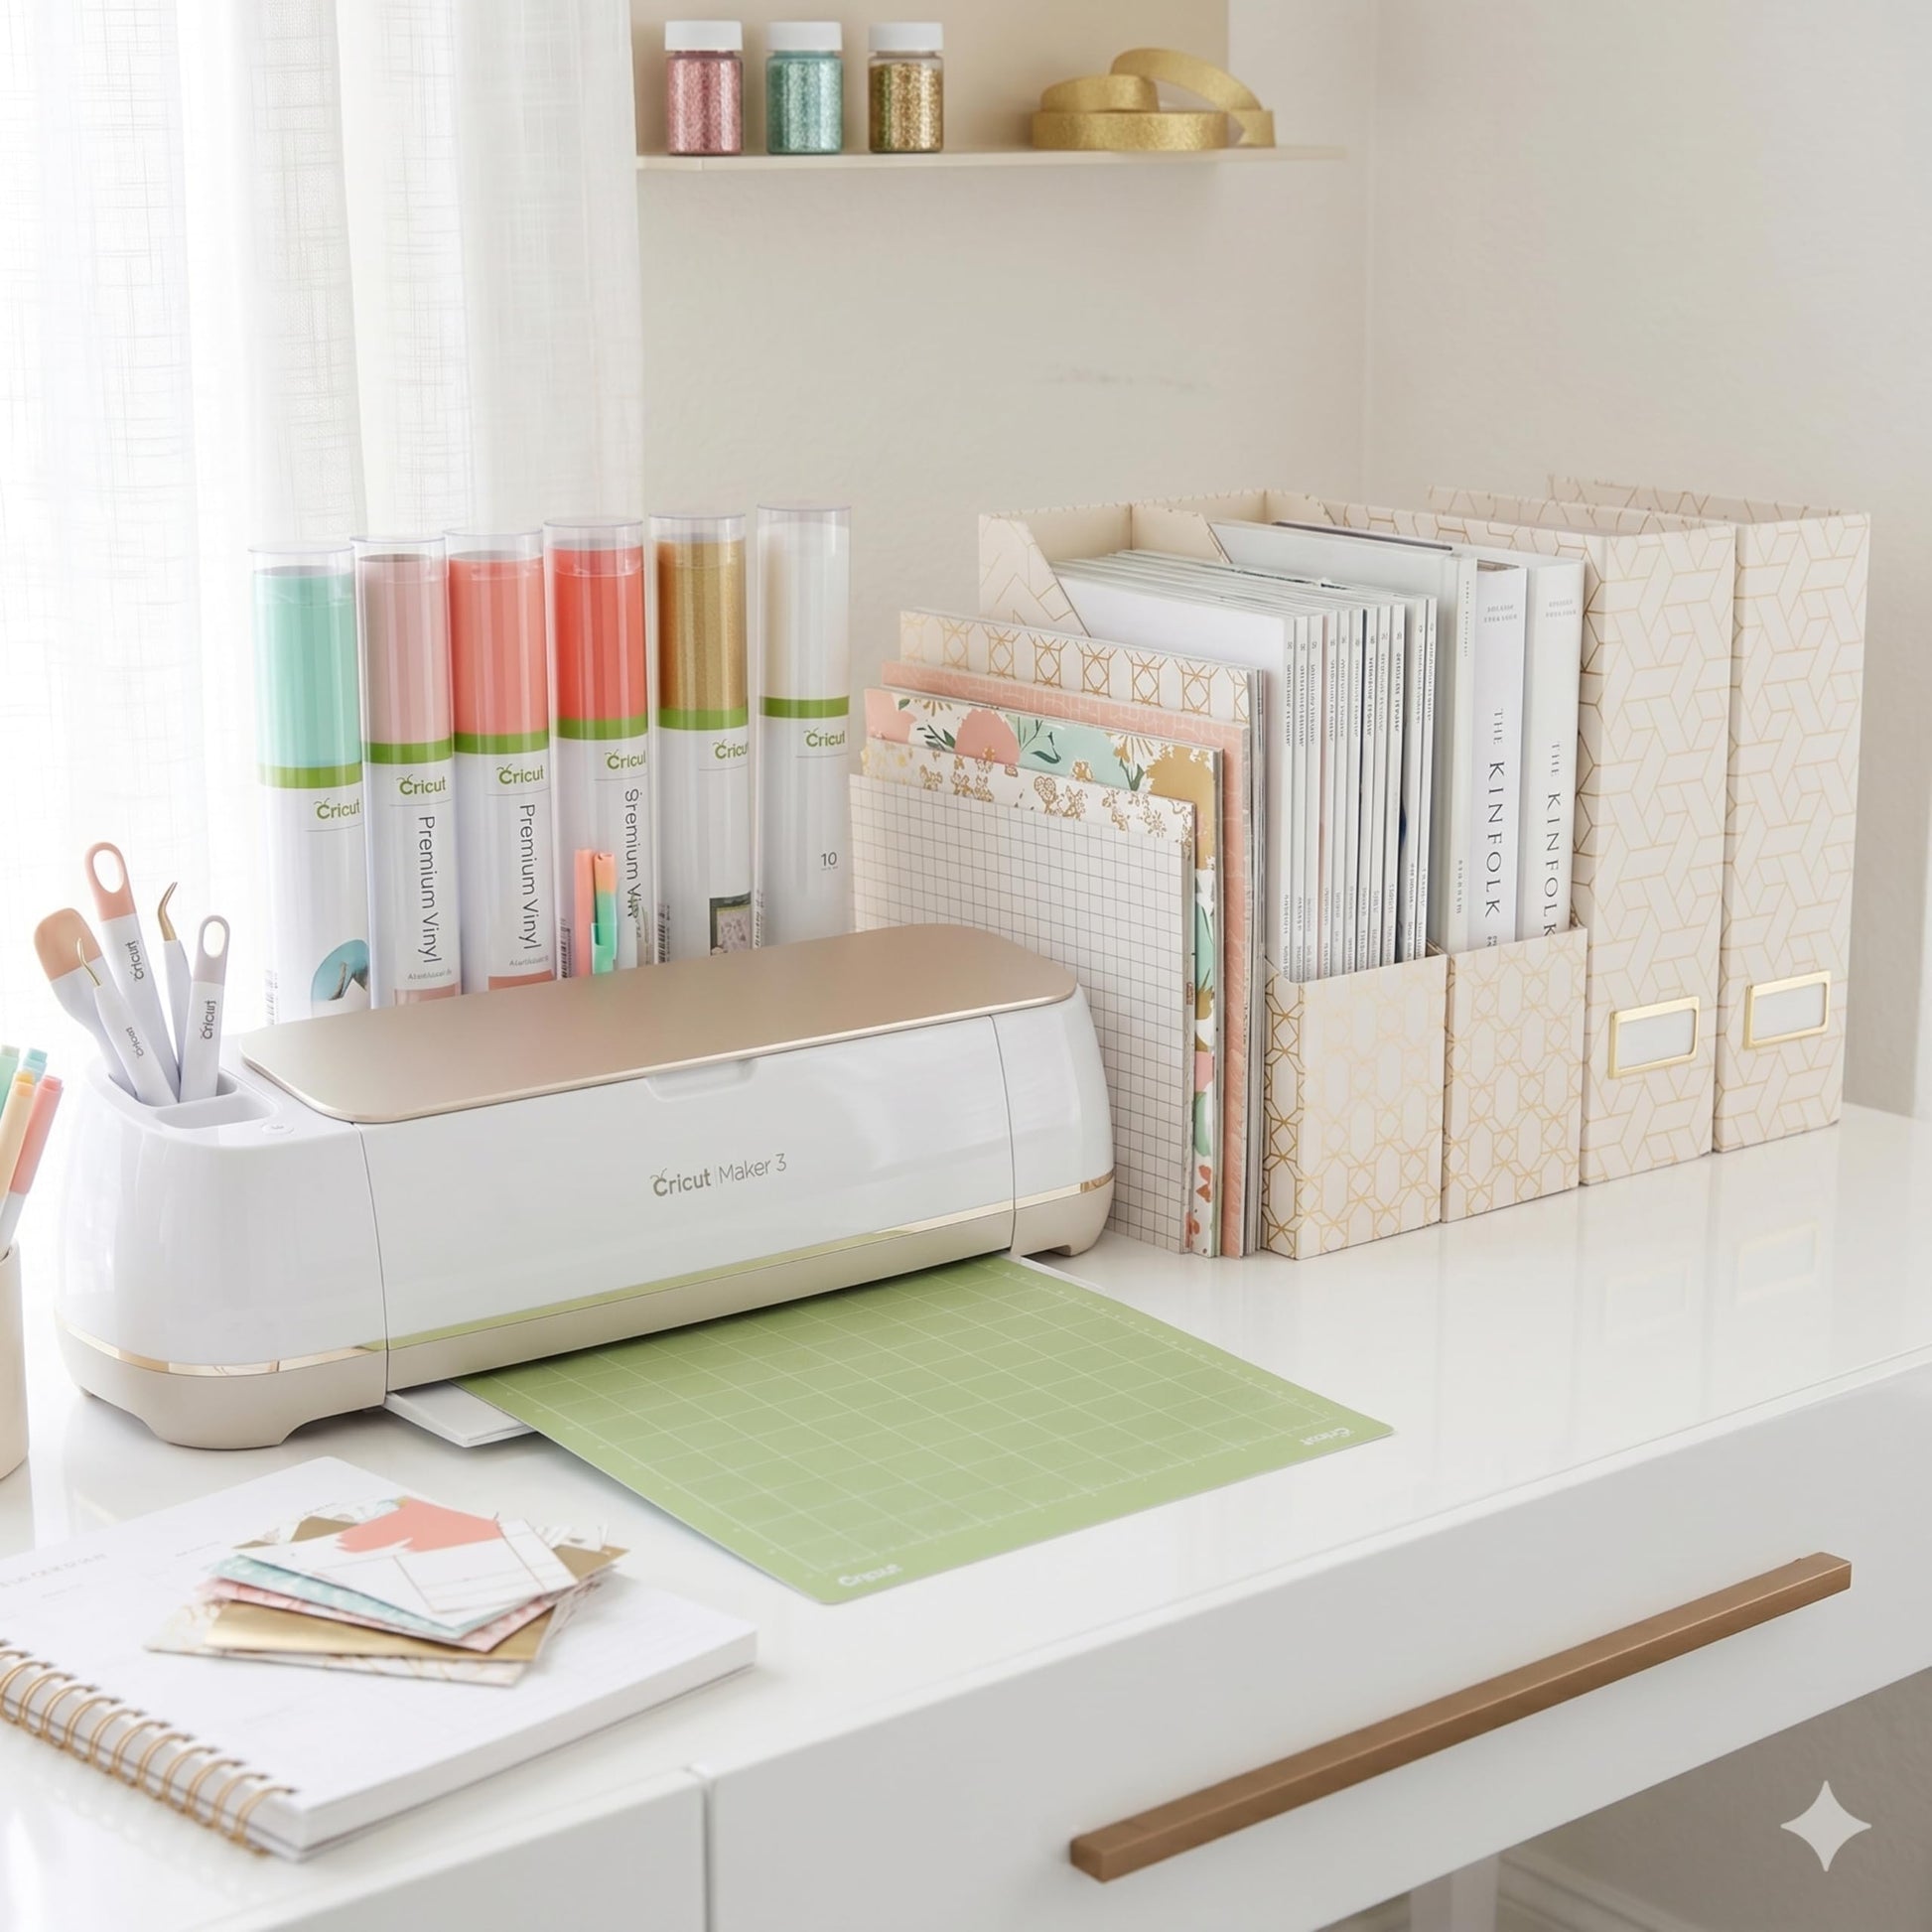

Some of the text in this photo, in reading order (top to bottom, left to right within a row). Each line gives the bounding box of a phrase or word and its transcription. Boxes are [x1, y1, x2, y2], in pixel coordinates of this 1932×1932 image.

[712, 739, 749, 759] Cricu
[397, 774, 446, 794] Cricut
[497, 763, 544, 784] Cricut
[314, 797, 360, 819] Cricut
[1485, 708, 1505, 917] THE KINFOLK
[417, 815, 438, 909] Premium
[518, 804, 537, 896] Premium
[821, 852, 837, 866] 10
[1543, 742, 1561, 936] THE KINFOLK
[417, 911, 443, 963] Vinyl
[518, 898, 542, 950] Vinyl
[650, 1153, 787, 1196] Cricut Maker 3
